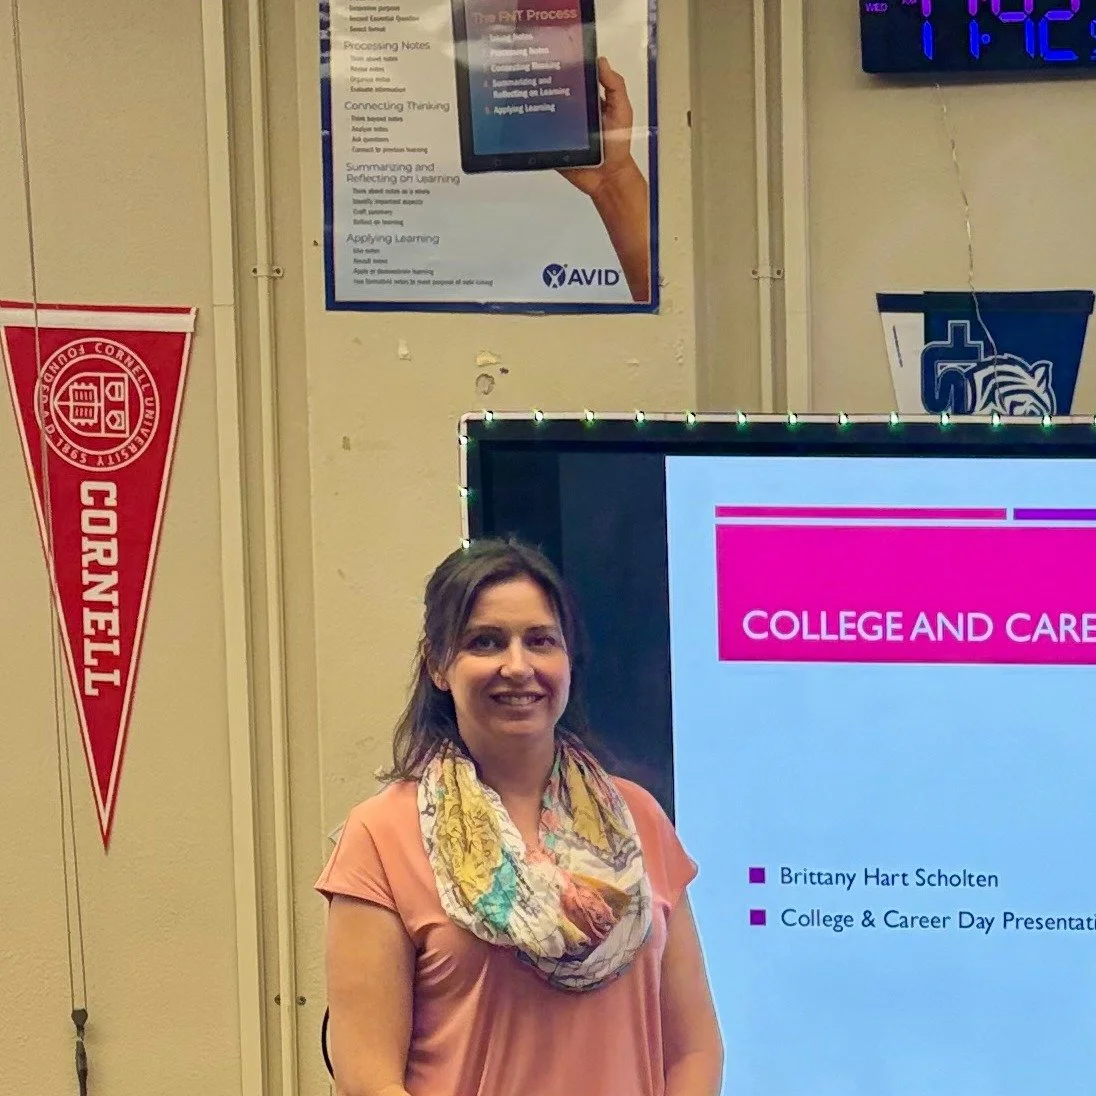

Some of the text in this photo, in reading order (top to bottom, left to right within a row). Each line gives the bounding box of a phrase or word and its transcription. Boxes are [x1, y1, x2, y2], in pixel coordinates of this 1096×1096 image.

[526, 9, 578, 21] Process
[343, 41, 431, 52] Processing Notes
[344, 101, 450, 112] Connecting Thinking
[346, 162, 435, 173] Summarizing and
[346, 173, 460, 186] Reflecting on Learning
[346, 233, 440, 245] Applying Learning
[567, 268, 620, 286] AVID
[40, 344, 86, 404] FOUNDED
[94, 342, 155, 467] CORNELL UNIVERSITY
[56, 437, 88, 464] 1865
[80, 480, 121, 697] CORNELL
[742, 609, 904, 642] COLLEGE
[910, 612, 994, 642] AND
[780, 867, 999, 890] Brittany Hart Scholten
[781, 908, 854, 932] College
[861, 911, 876, 929] &
[884, 911, 951, 929] Career
[958, 912, 995, 935] Day
